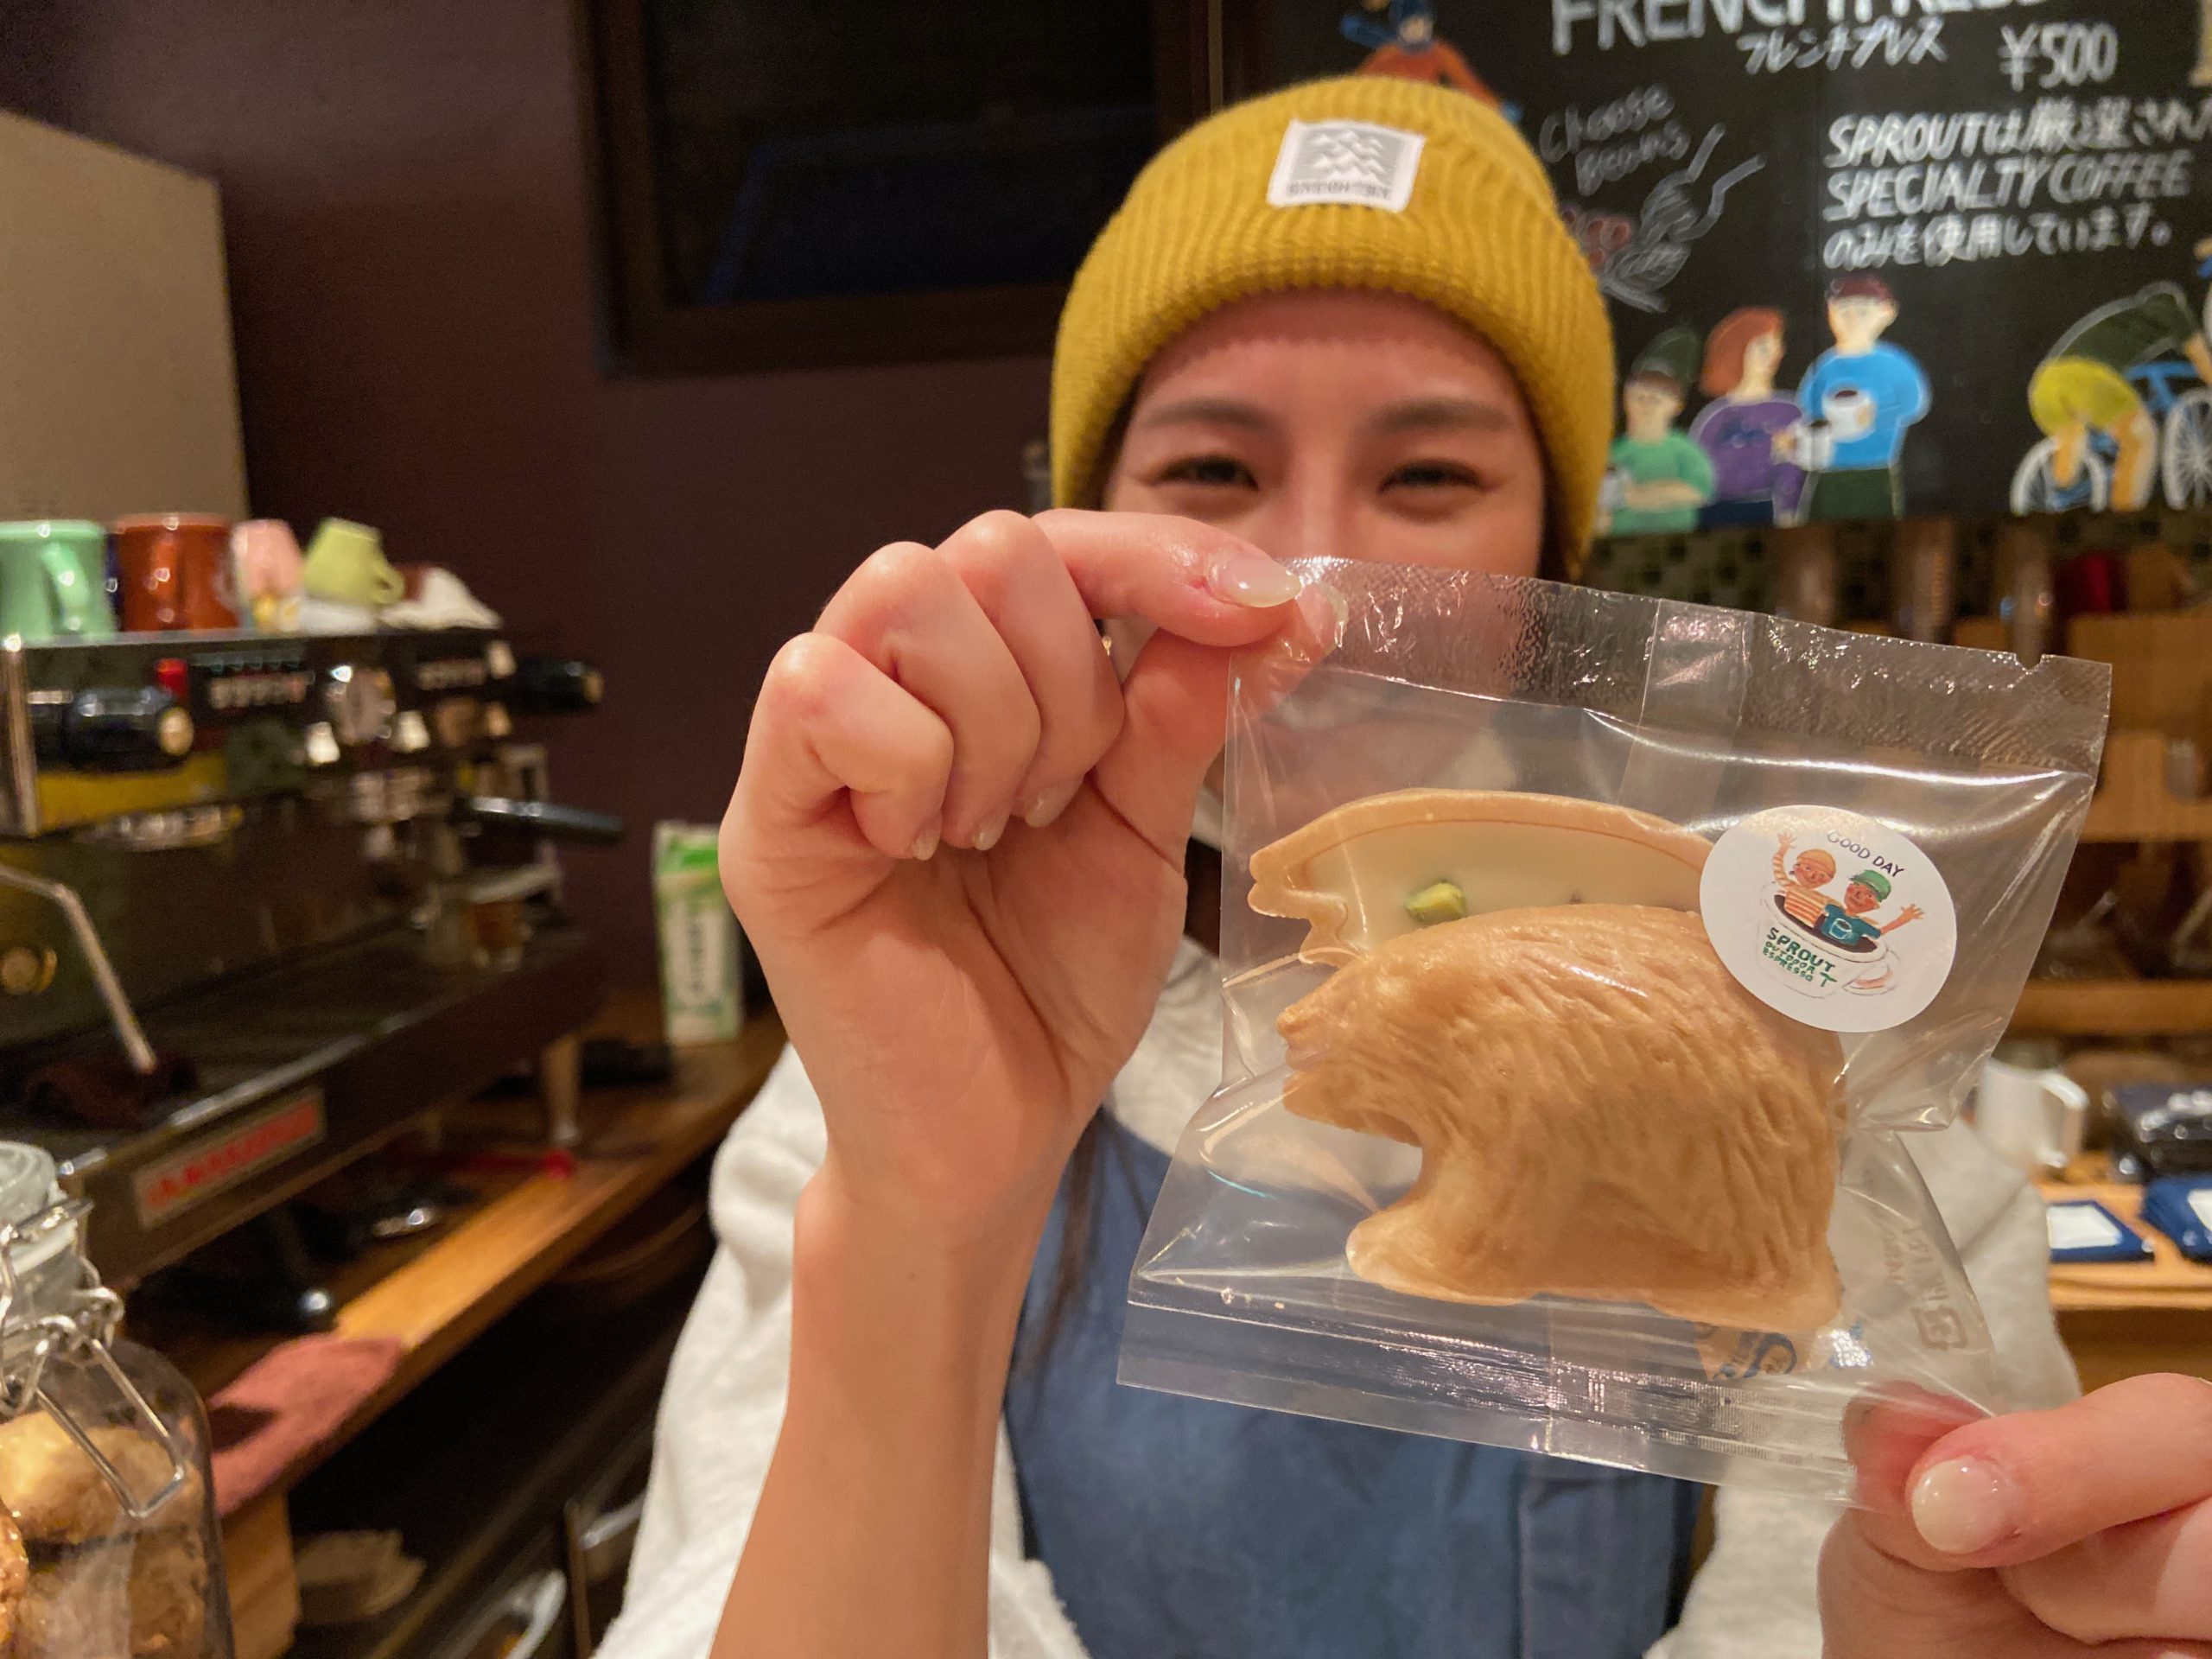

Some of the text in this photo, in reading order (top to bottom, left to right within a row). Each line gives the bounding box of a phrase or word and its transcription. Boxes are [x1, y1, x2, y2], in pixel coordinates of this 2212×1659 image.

[1998, 22, 2118, 92] ¥500
[1823, 149, 2194, 222] SPECIALTY COFFEE
[1827, 830, 1904, 877] GOOD DAY
[1763, 946, 1813, 982] ESPRESSO
[1767, 927, 1835, 972] SPROUT
